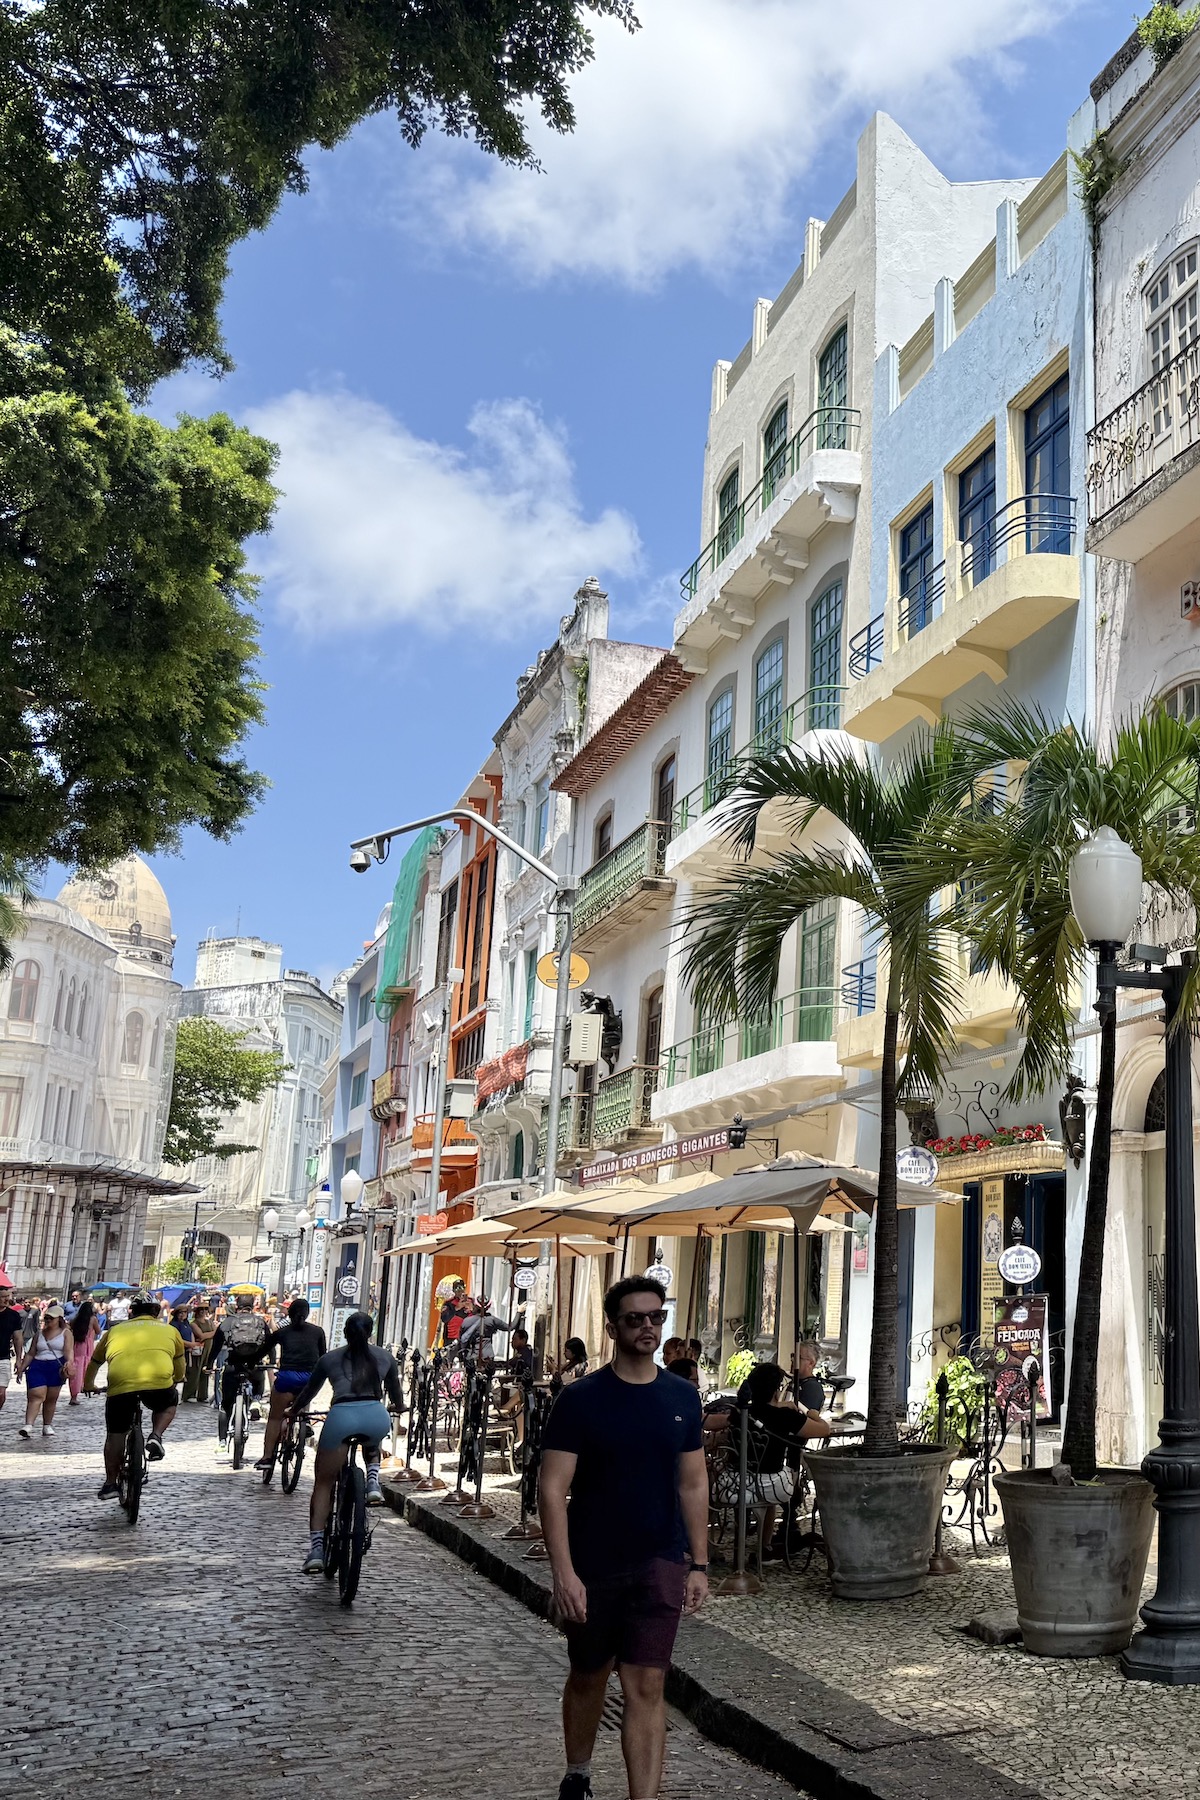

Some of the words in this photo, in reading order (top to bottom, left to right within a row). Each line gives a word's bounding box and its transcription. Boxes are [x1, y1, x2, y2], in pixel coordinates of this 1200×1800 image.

[583, 1160, 619, 1178] EMBAIXADA
[622, 1155, 638, 1169] DOS
[640, 1144, 678, 1165] BONECOS
[681, 1131, 728, 1154] GIGANTES
[997, 1328, 1041, 1343] FEIJOADA
